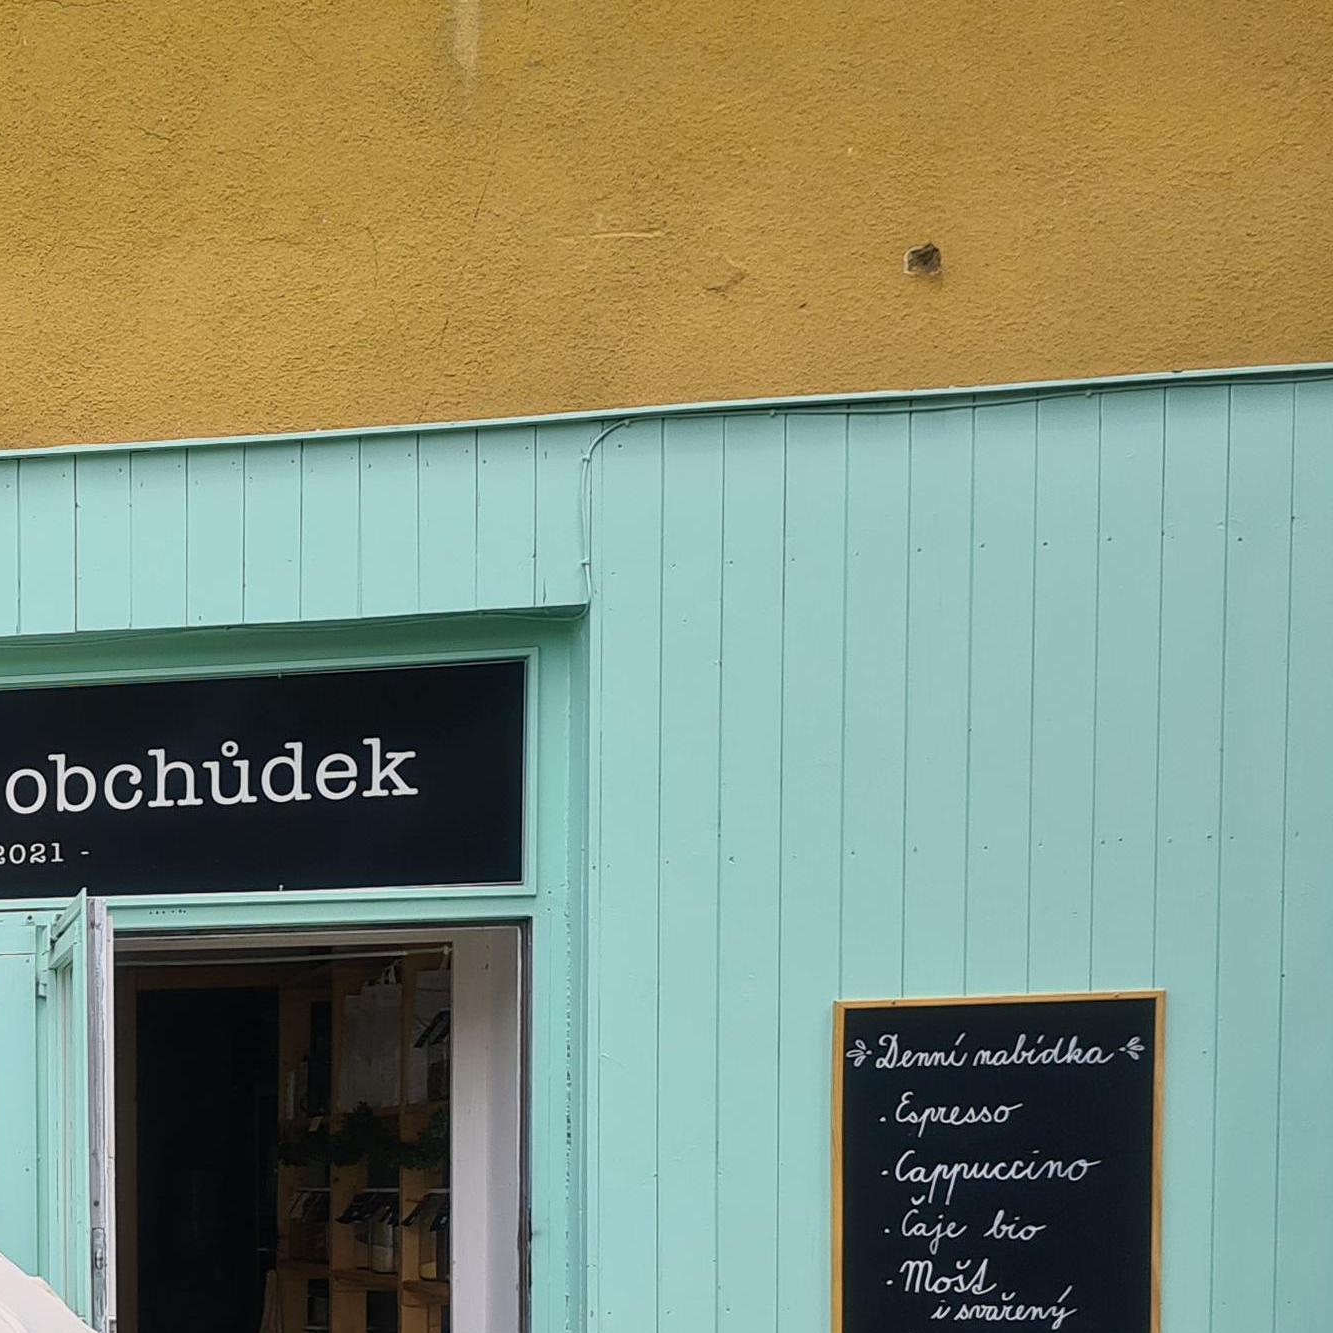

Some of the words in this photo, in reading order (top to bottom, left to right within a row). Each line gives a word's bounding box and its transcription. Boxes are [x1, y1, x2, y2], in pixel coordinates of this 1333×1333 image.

[5, 737, 419, 815] obchůdek
[875, 1032, 968, 1069] Denní
[972, 1033, 1115, 1068] nabídka
[895, 1091, 1023, 1138] Espresso
[895, 1149, 1101, 1206] Cappuccino
[901, 1194, 967, 1255] Čaje
[983, 1209, 1047, 1241] bio
[899, 1258, 998, 1295] Mošt
[930, 1299, 951, 1320] i
[953, 1285, 1077, 1330] svařený
